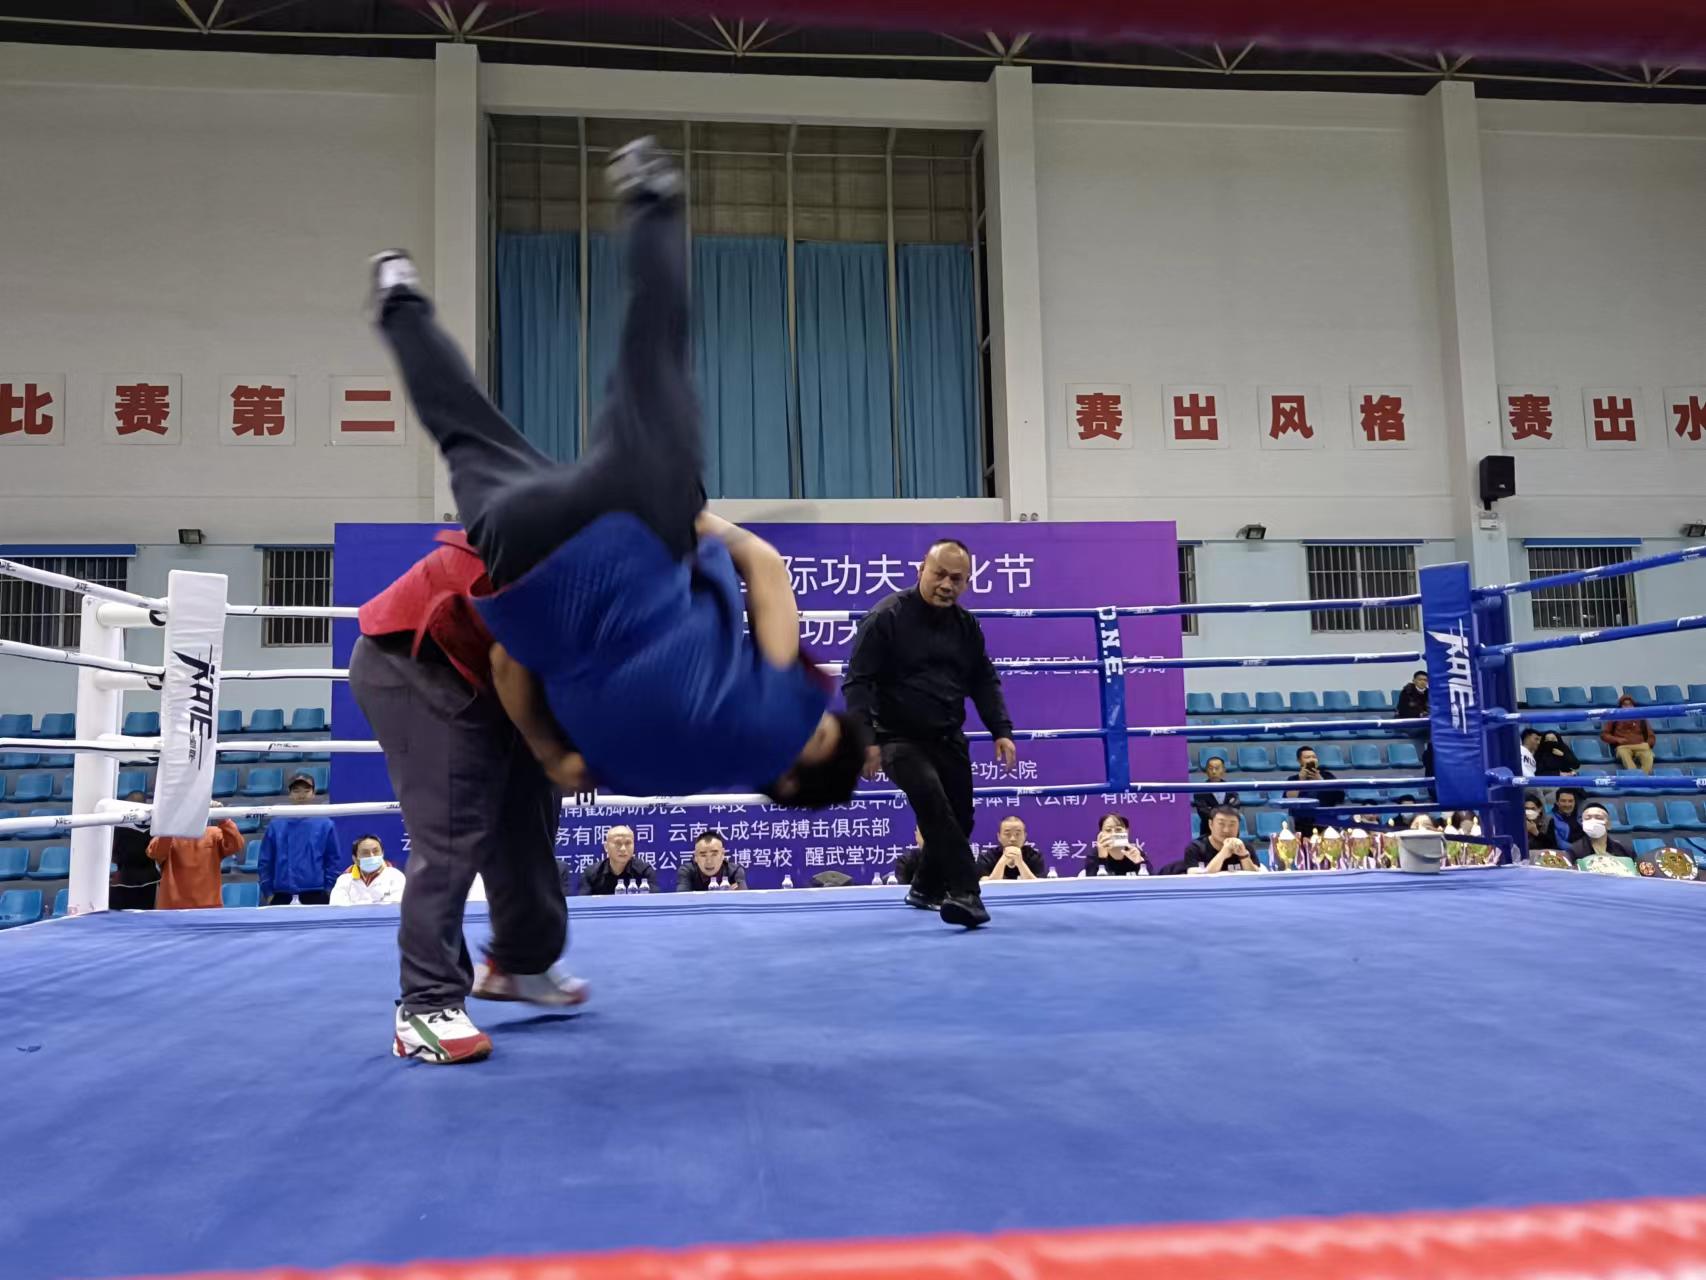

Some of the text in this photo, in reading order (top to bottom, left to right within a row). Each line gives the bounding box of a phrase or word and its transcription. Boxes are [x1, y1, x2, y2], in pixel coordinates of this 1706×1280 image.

[1075, 392, 1406, 442] 赛出风格
[739, 552, 1035, 596] 际功夫化节
[804, 843, 920, 866] 醒武堂功夫
